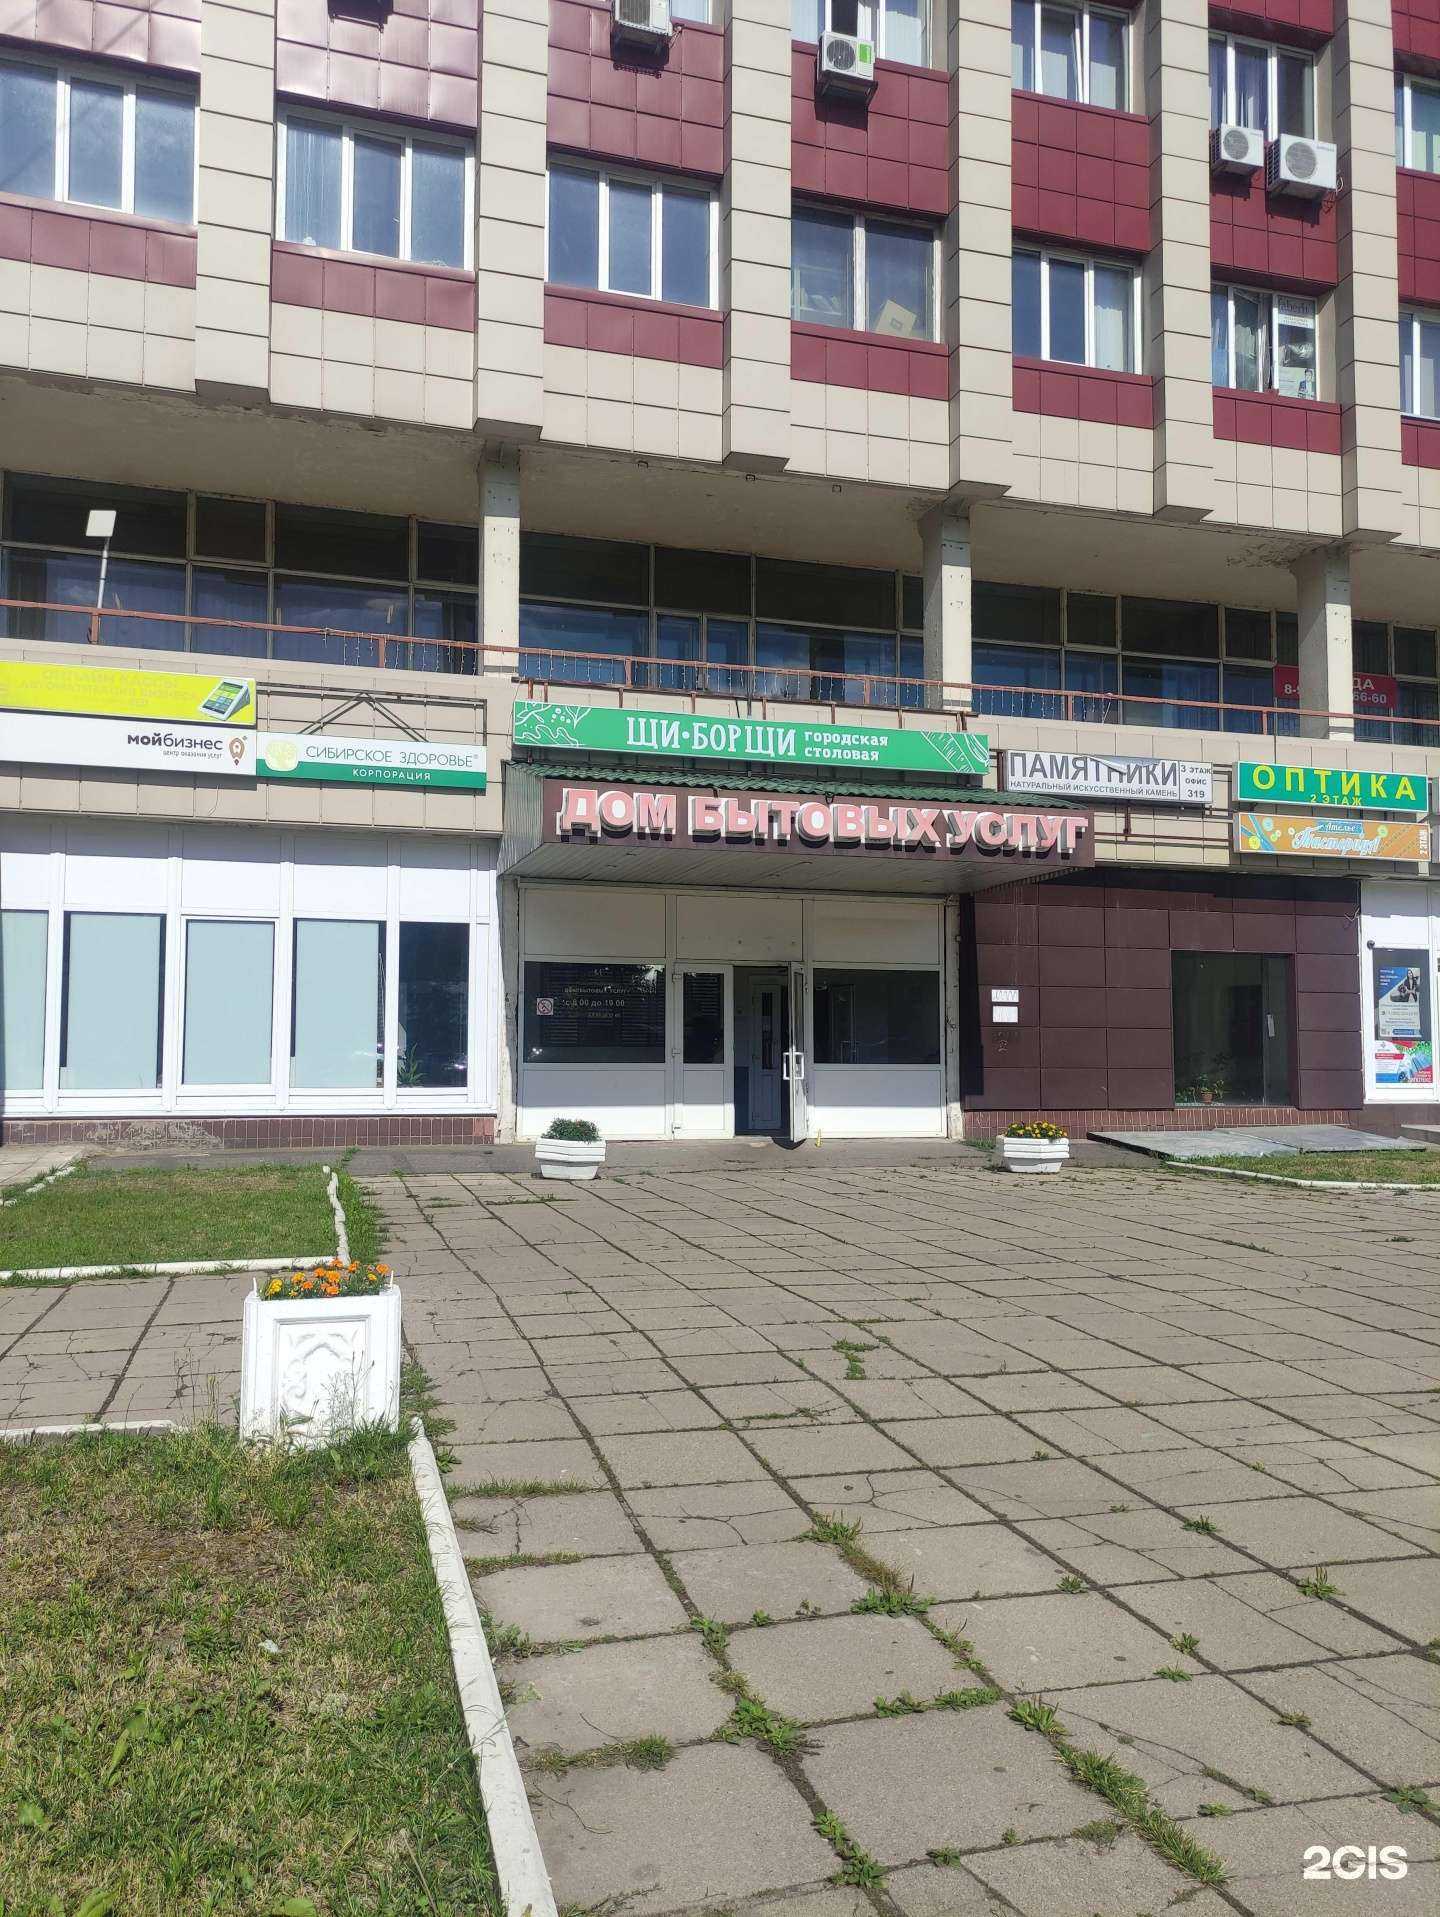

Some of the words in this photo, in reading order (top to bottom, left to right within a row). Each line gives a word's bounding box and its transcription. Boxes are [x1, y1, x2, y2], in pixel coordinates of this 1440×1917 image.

[804, 732, 888, 747] городская
[306, 745, 393, 763] СИБИРСКОЕ
[804, 745, 879, 761] столовая
[352, 768, 431, 781] КОРПОРАЦИЯ
[1181, 764, 1186, 773] 3
[1010, 780, 1070, 791] НАТУРАЛЬНЫЙ
[1073, 784, 1143, 796] ИСКУССТВЕННЫЙ
[1145, 788, 1178, 798] КАМЕНЬ
[1253, 765, 1416, 801] ОПТИКА
[1187, 789, 1206, 799] 319
[1310, 794, 1317, 804] 2
[1322, 796, 1362, 807] ЭТАЖ
[556, 788, 677, 837] ДОМ
[688, 795, 941, 848] БЫТОВЫХ
[943, 809, 1089, 854] УСЛУГ
